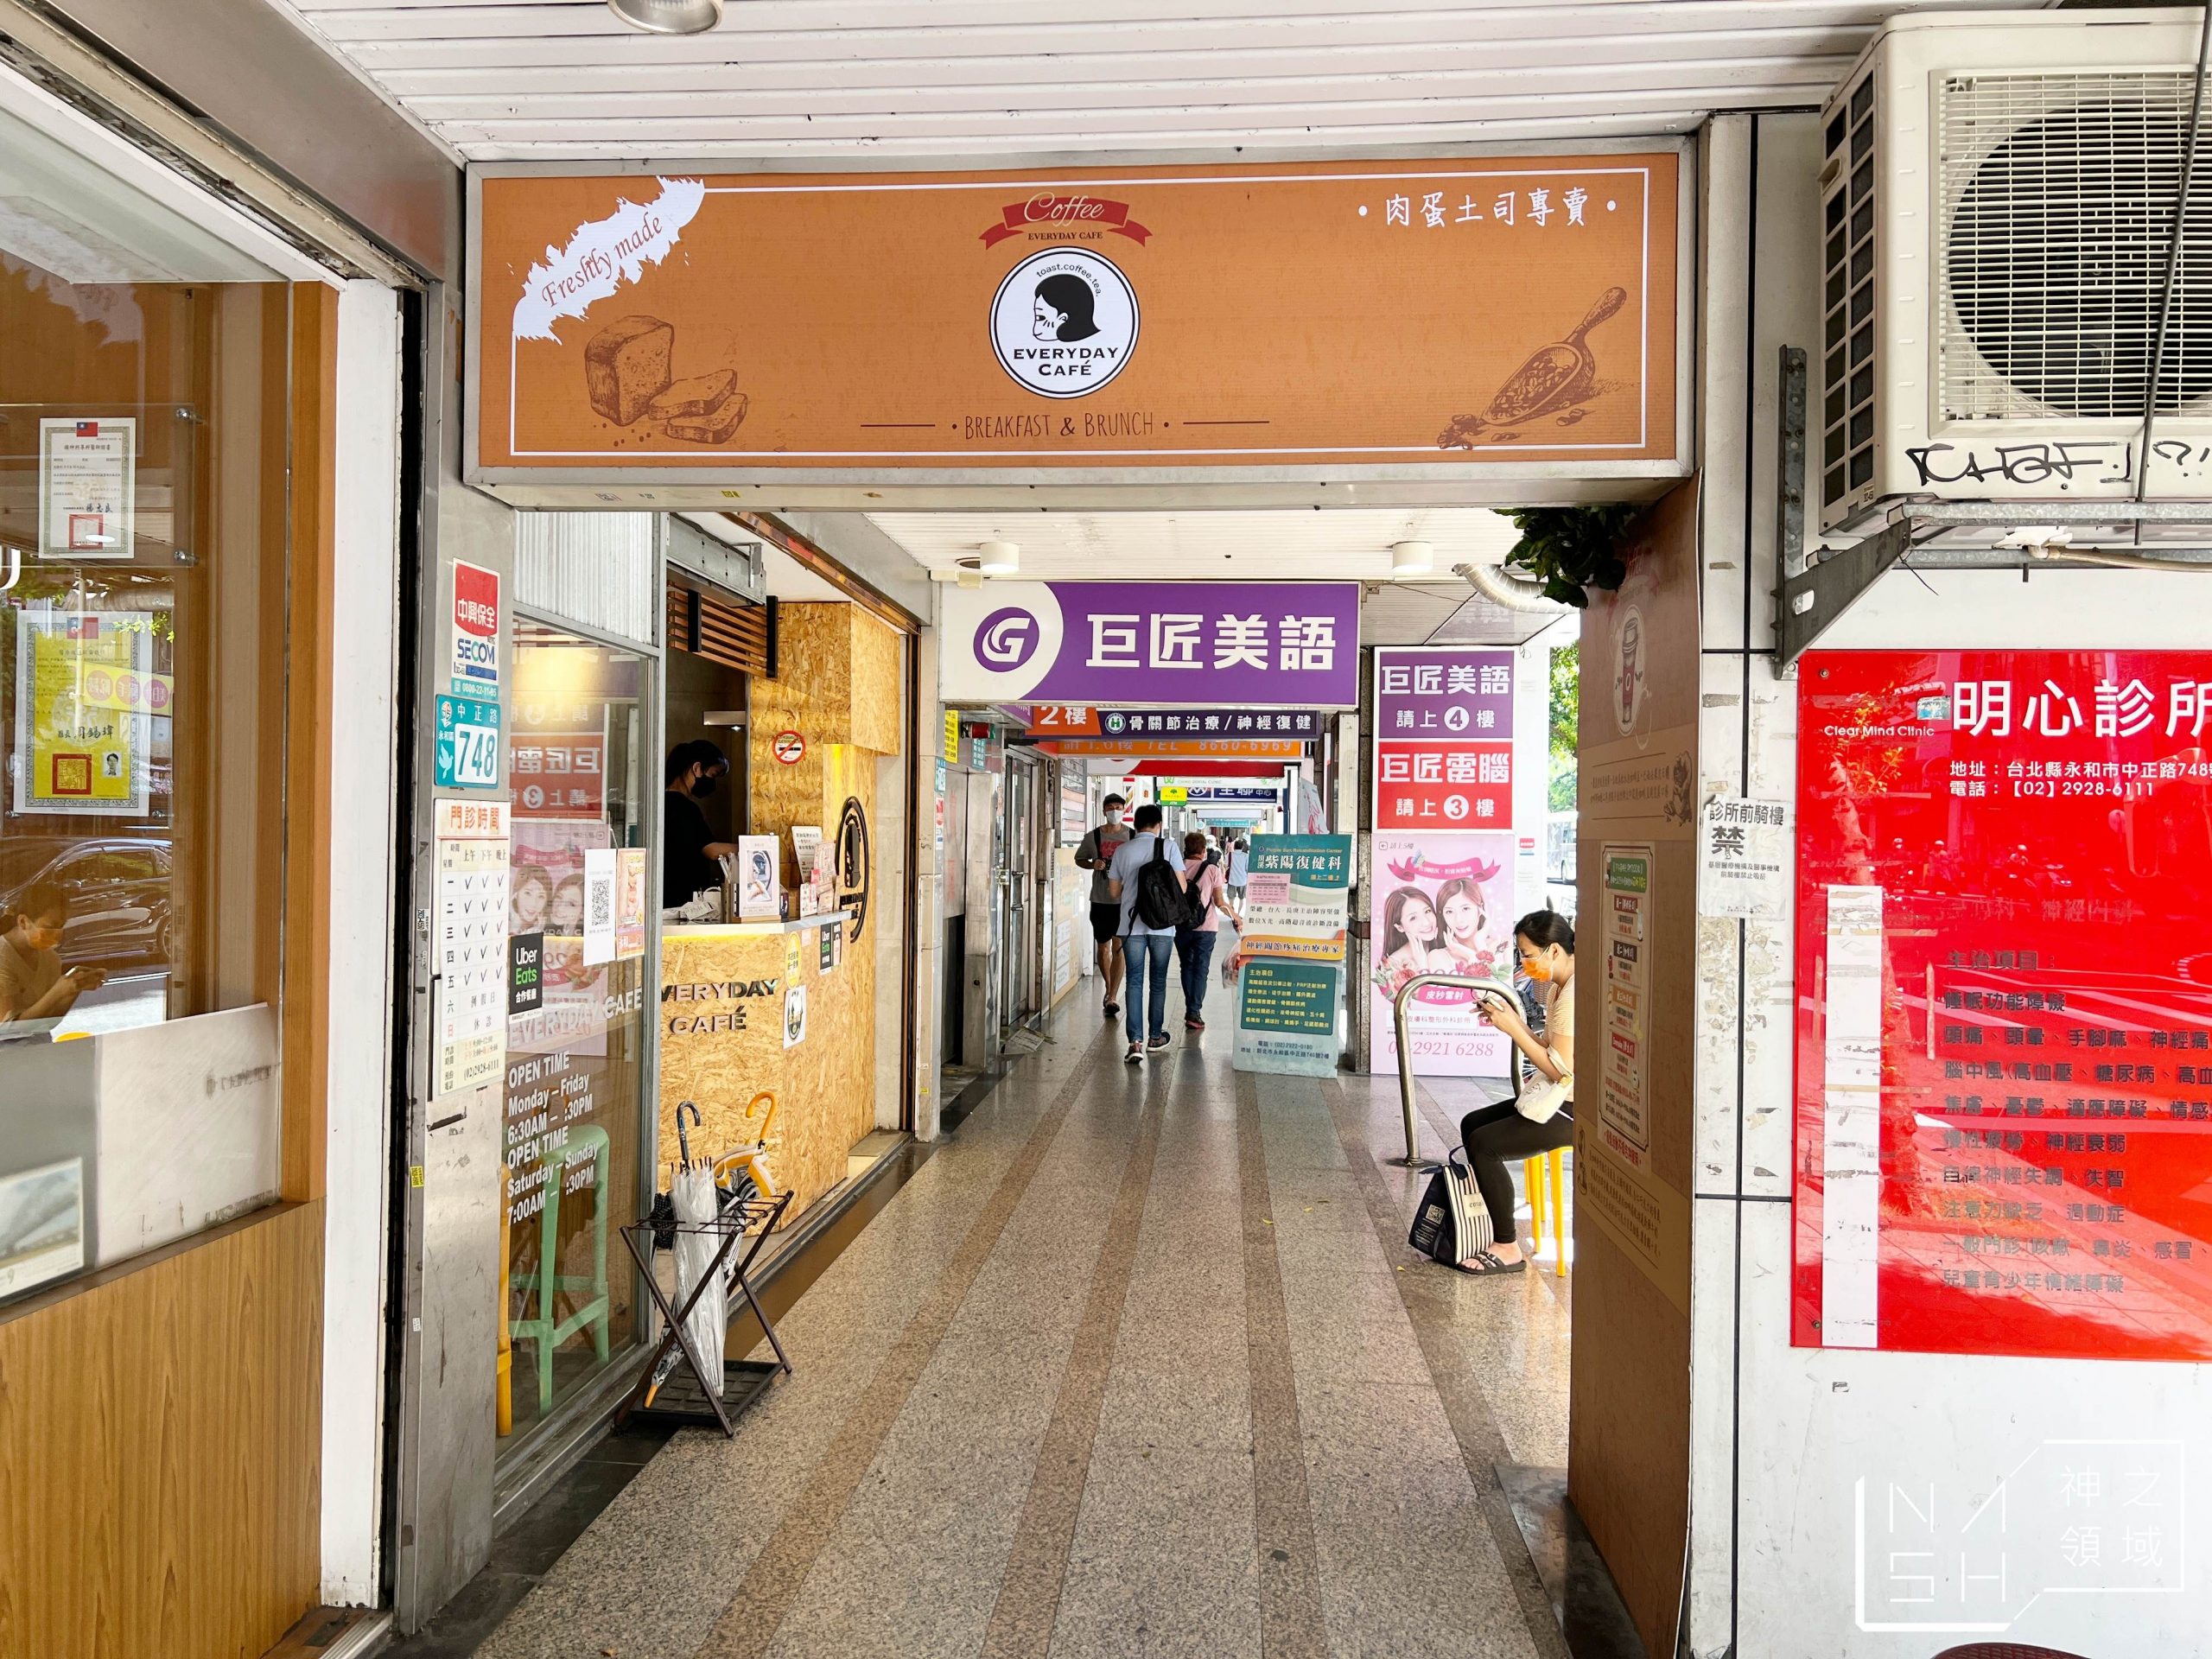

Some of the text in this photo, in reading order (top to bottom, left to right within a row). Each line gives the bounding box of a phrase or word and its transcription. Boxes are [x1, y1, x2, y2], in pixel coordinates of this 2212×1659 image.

[1024, 192, 1104, 226] Coffee
[1386, 188, 1589, 227] 肉蛋土司專賣
[613, 212, 663, 259] made
[1013, 347, 1119, 361] EVERYDAY
[1038, 360, 1092, 377] CAFÉ
[964, 413, 1154, 439] BREAKFAST & BRUNCH
[458, 599, 494, 628] 中興保全
[457, 638, 495, 664] SECOM
[1086, 613, 1336, 671] 巨匠美語
[1382, 664, 1510, 695] 巨匠美語
[457, 702, 498, 724] 中正路
[1952, 678, 2212, 739] 明心診所
[1129, 715, 1311, 731] 骨關節治療/神經復健
[1824, 725, 1935, 737] Clear Mind Clinic
[458, 730, 495, 778] 748
[1381, 753, 1510, 783] 巨匠電腦
[451, 805, 499, 830] 門診時間
[1709, 801, 1784, 825] 診所前騎樓
[464, 849, 475, 861] 上午
[481, 849, 492, 861] 下午
[1711, 826, 1745, 859] 禁
[1266, 855, 1342, 870] 紫陽復健科
[447, 903, 454, 914] 二
[447, 927, 454, 939] 三
[447, 950, 454, 963] 四
[516, 947, 537, 965] Uber
[448, 976, 454, 988] 五
[515, 967, 537, 985] Eats
[661, 978, 778, 1001] VERYDAY
[1426, 989, 1465, 1001] 皮秒雷射
[1944, 992, 2066, 1012] 睡眠功能障礙
[508, 999, 602, 1049] EVERYDAY
[670, 1005, 747, 1034] CAFÉ
[1456, 1042, 1494, 1057] 6288
[508, 1050, 569, 1089] OPEN TIME
[508, 1086, 550, 1117] Monday
[561, 1073, 589, 1103] Friday
[507, 1116, 548, 1146] 6:30AM
[507, 1125, 569, 1171] OPEN TIME
[507, 1161, 554, 1199] Saturday
[565, 1141, 598, 1170] Sunday
[507, 1192, 546, 1227] 7:00AM
